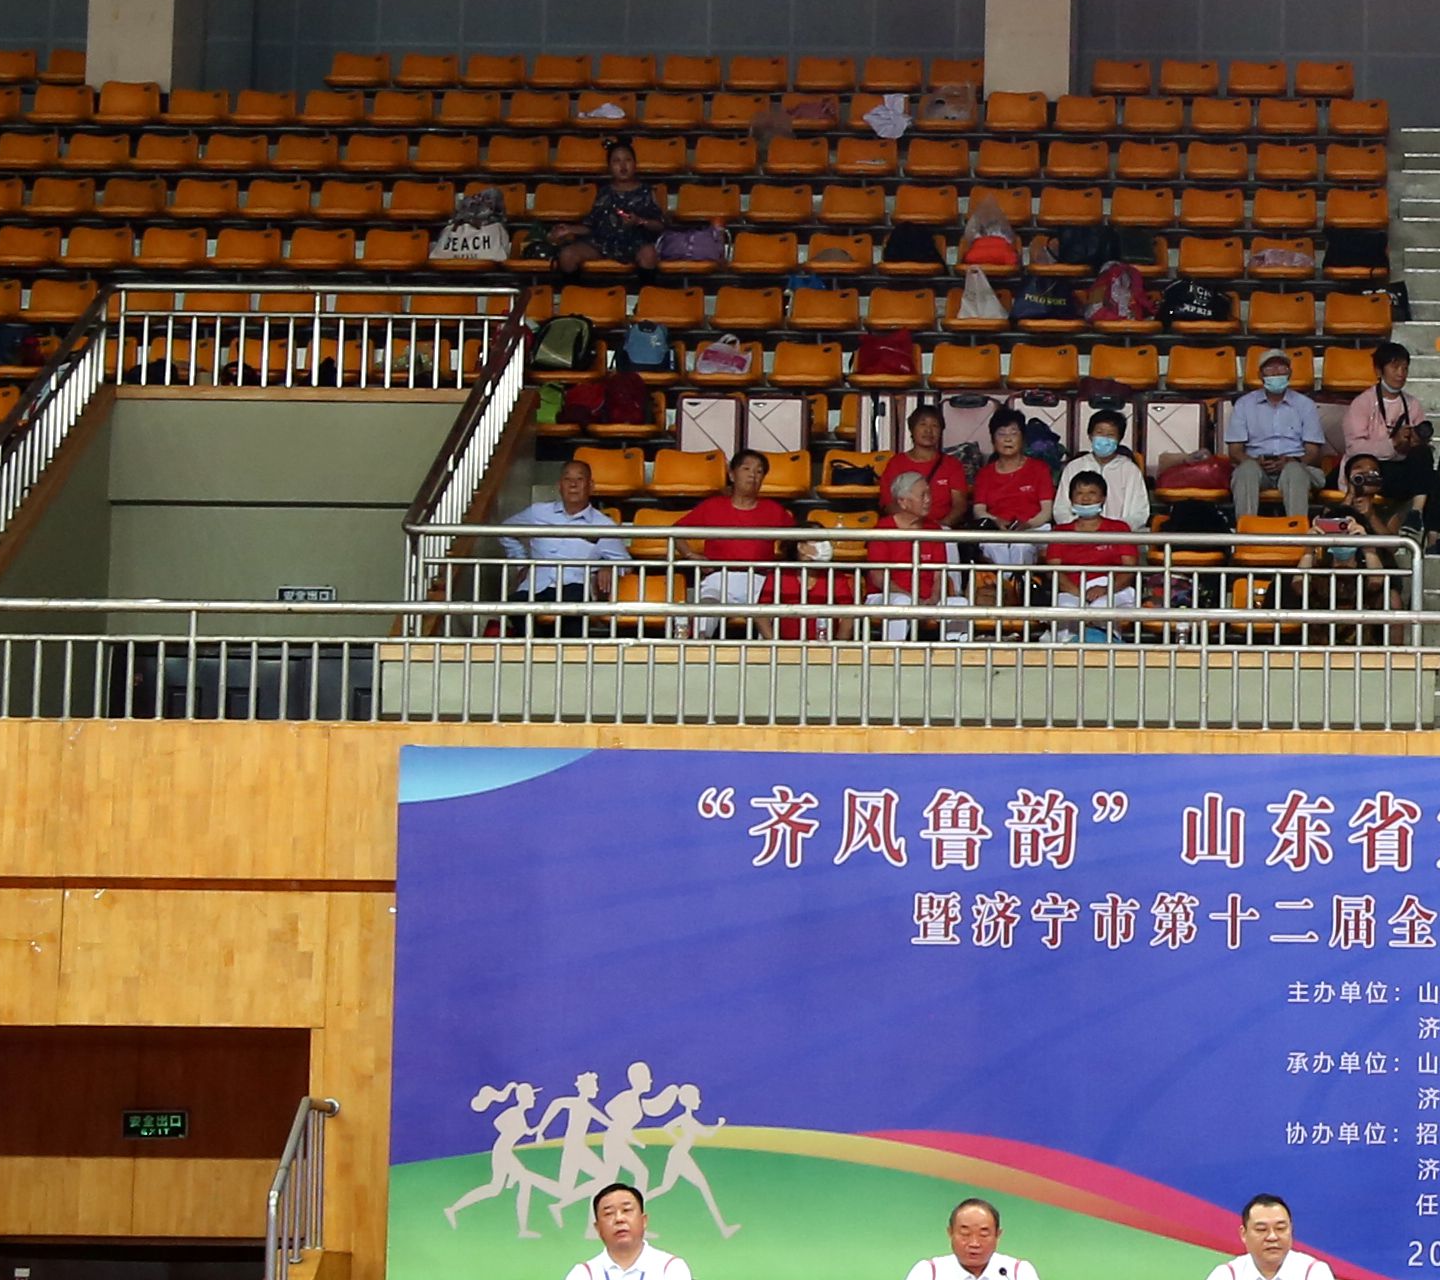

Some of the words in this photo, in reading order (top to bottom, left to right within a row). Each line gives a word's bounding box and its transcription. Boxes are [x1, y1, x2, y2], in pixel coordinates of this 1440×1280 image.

[696, 786, 1130, 871] “齐风鲁韵”
[1287, 981, 1401, 1005] 主办单位：
[1286, 1051, 1401, 1075] 承办单位：
[130, 1115, 182, 1128] 安全出口
[1285, 1122, 1400, 1146] 协办单位：
